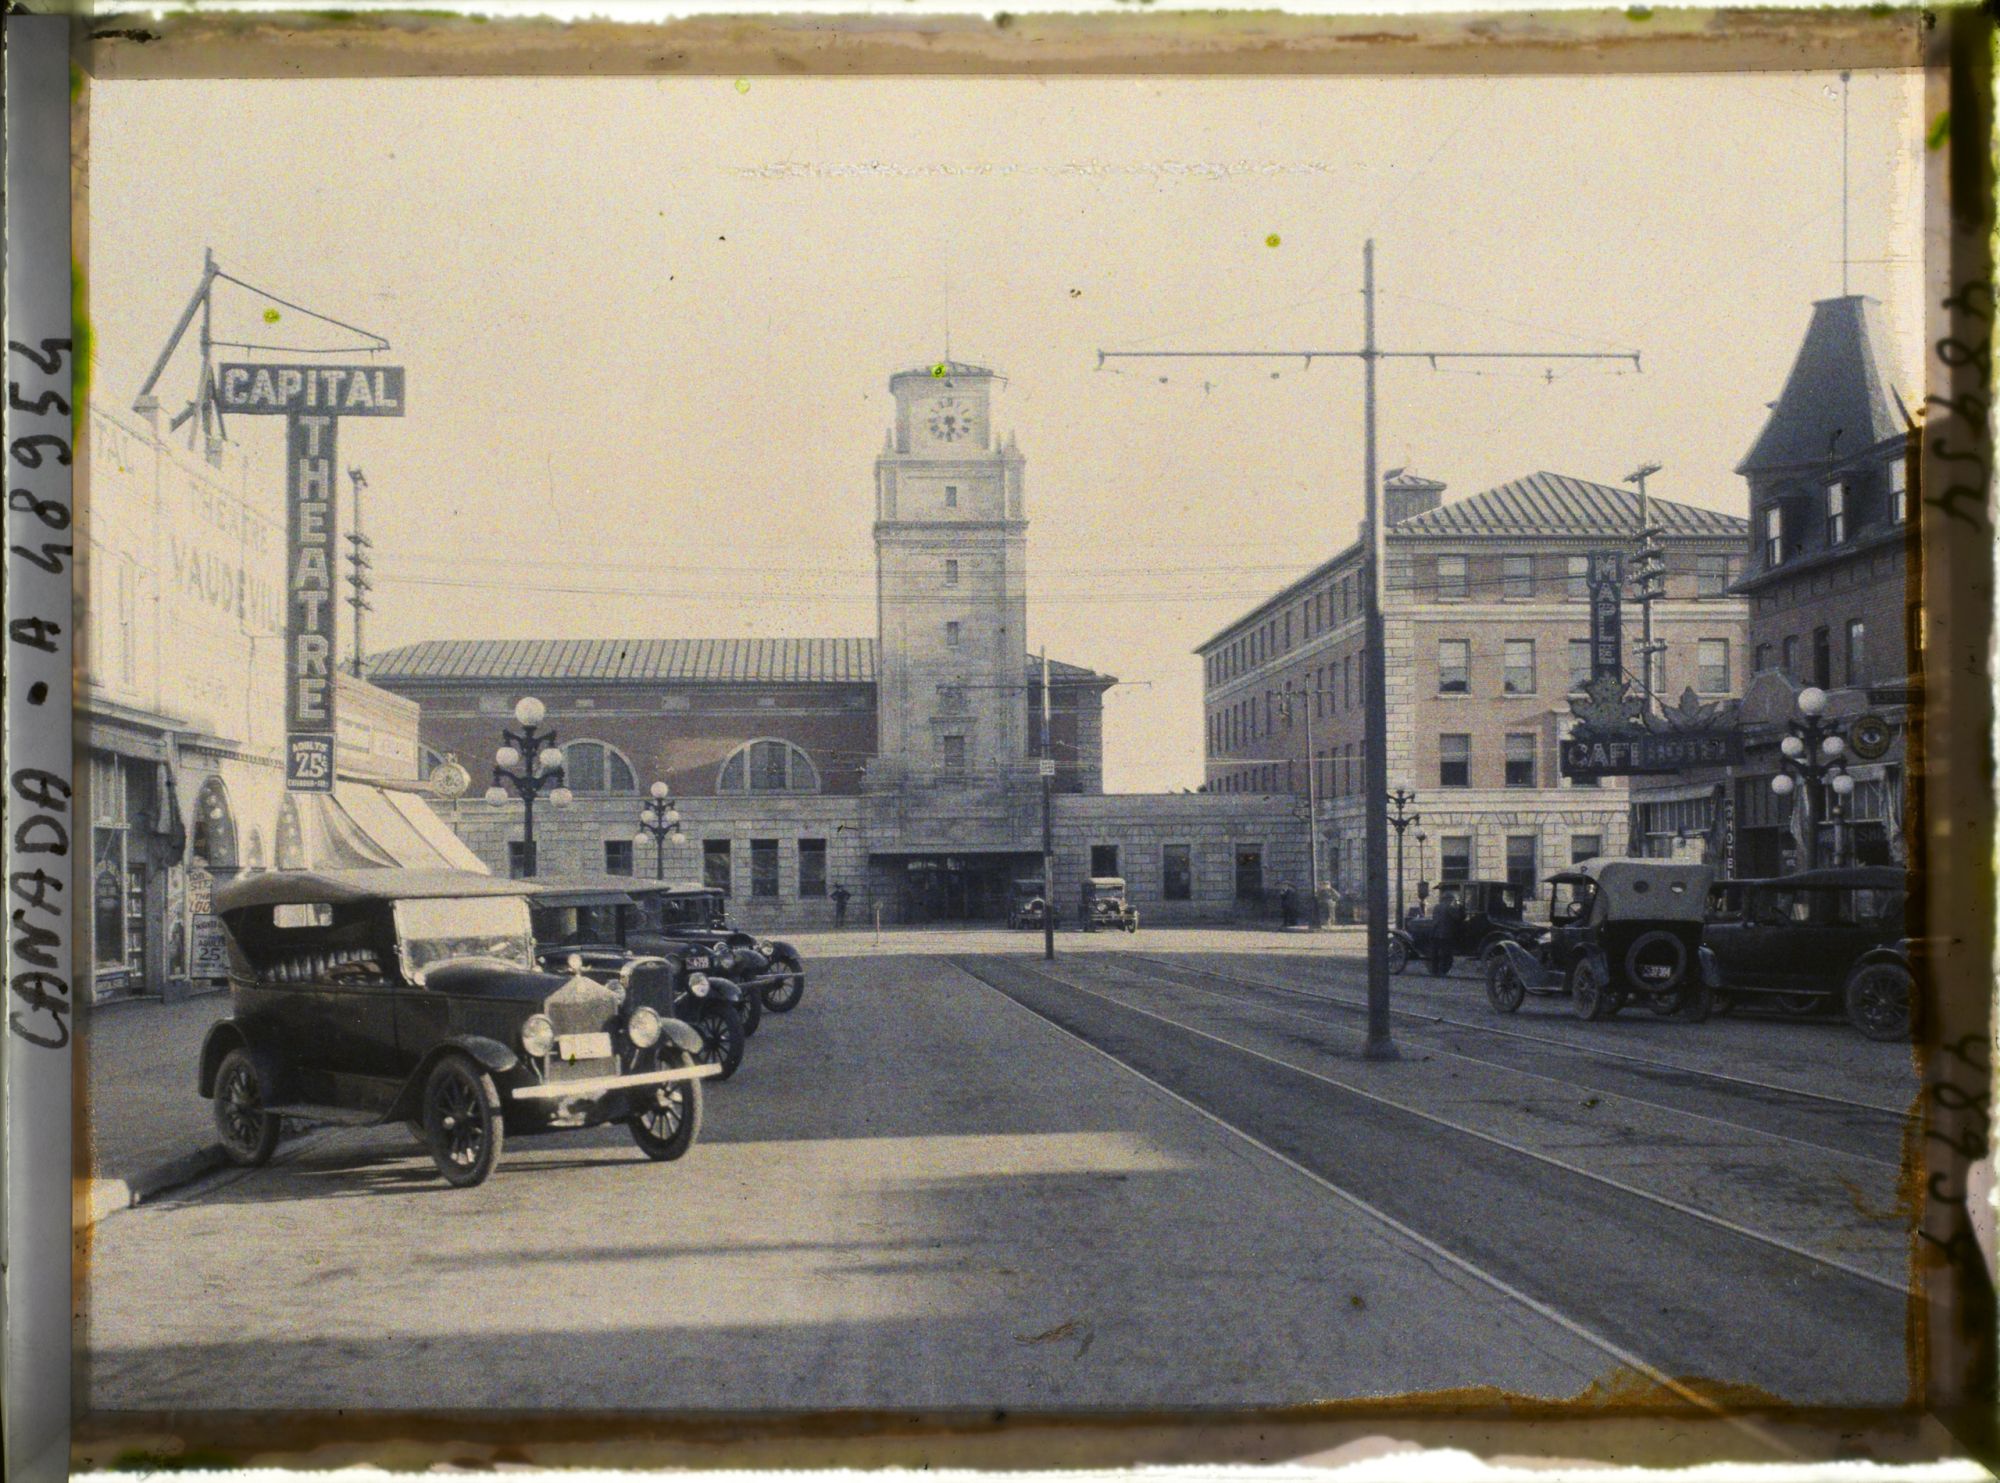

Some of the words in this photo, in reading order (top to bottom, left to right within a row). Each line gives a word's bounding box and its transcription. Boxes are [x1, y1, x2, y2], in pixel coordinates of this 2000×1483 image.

[8, 338, 73, 575] 48954
[225, 368, 397, 408] CAPITAL
[9, 617, 63, 654] A
[296, 416, 329, 720] THEATRE
[292, 741, 329, 753] ADULTS
[9, 768, 72, 1050] CANADA
